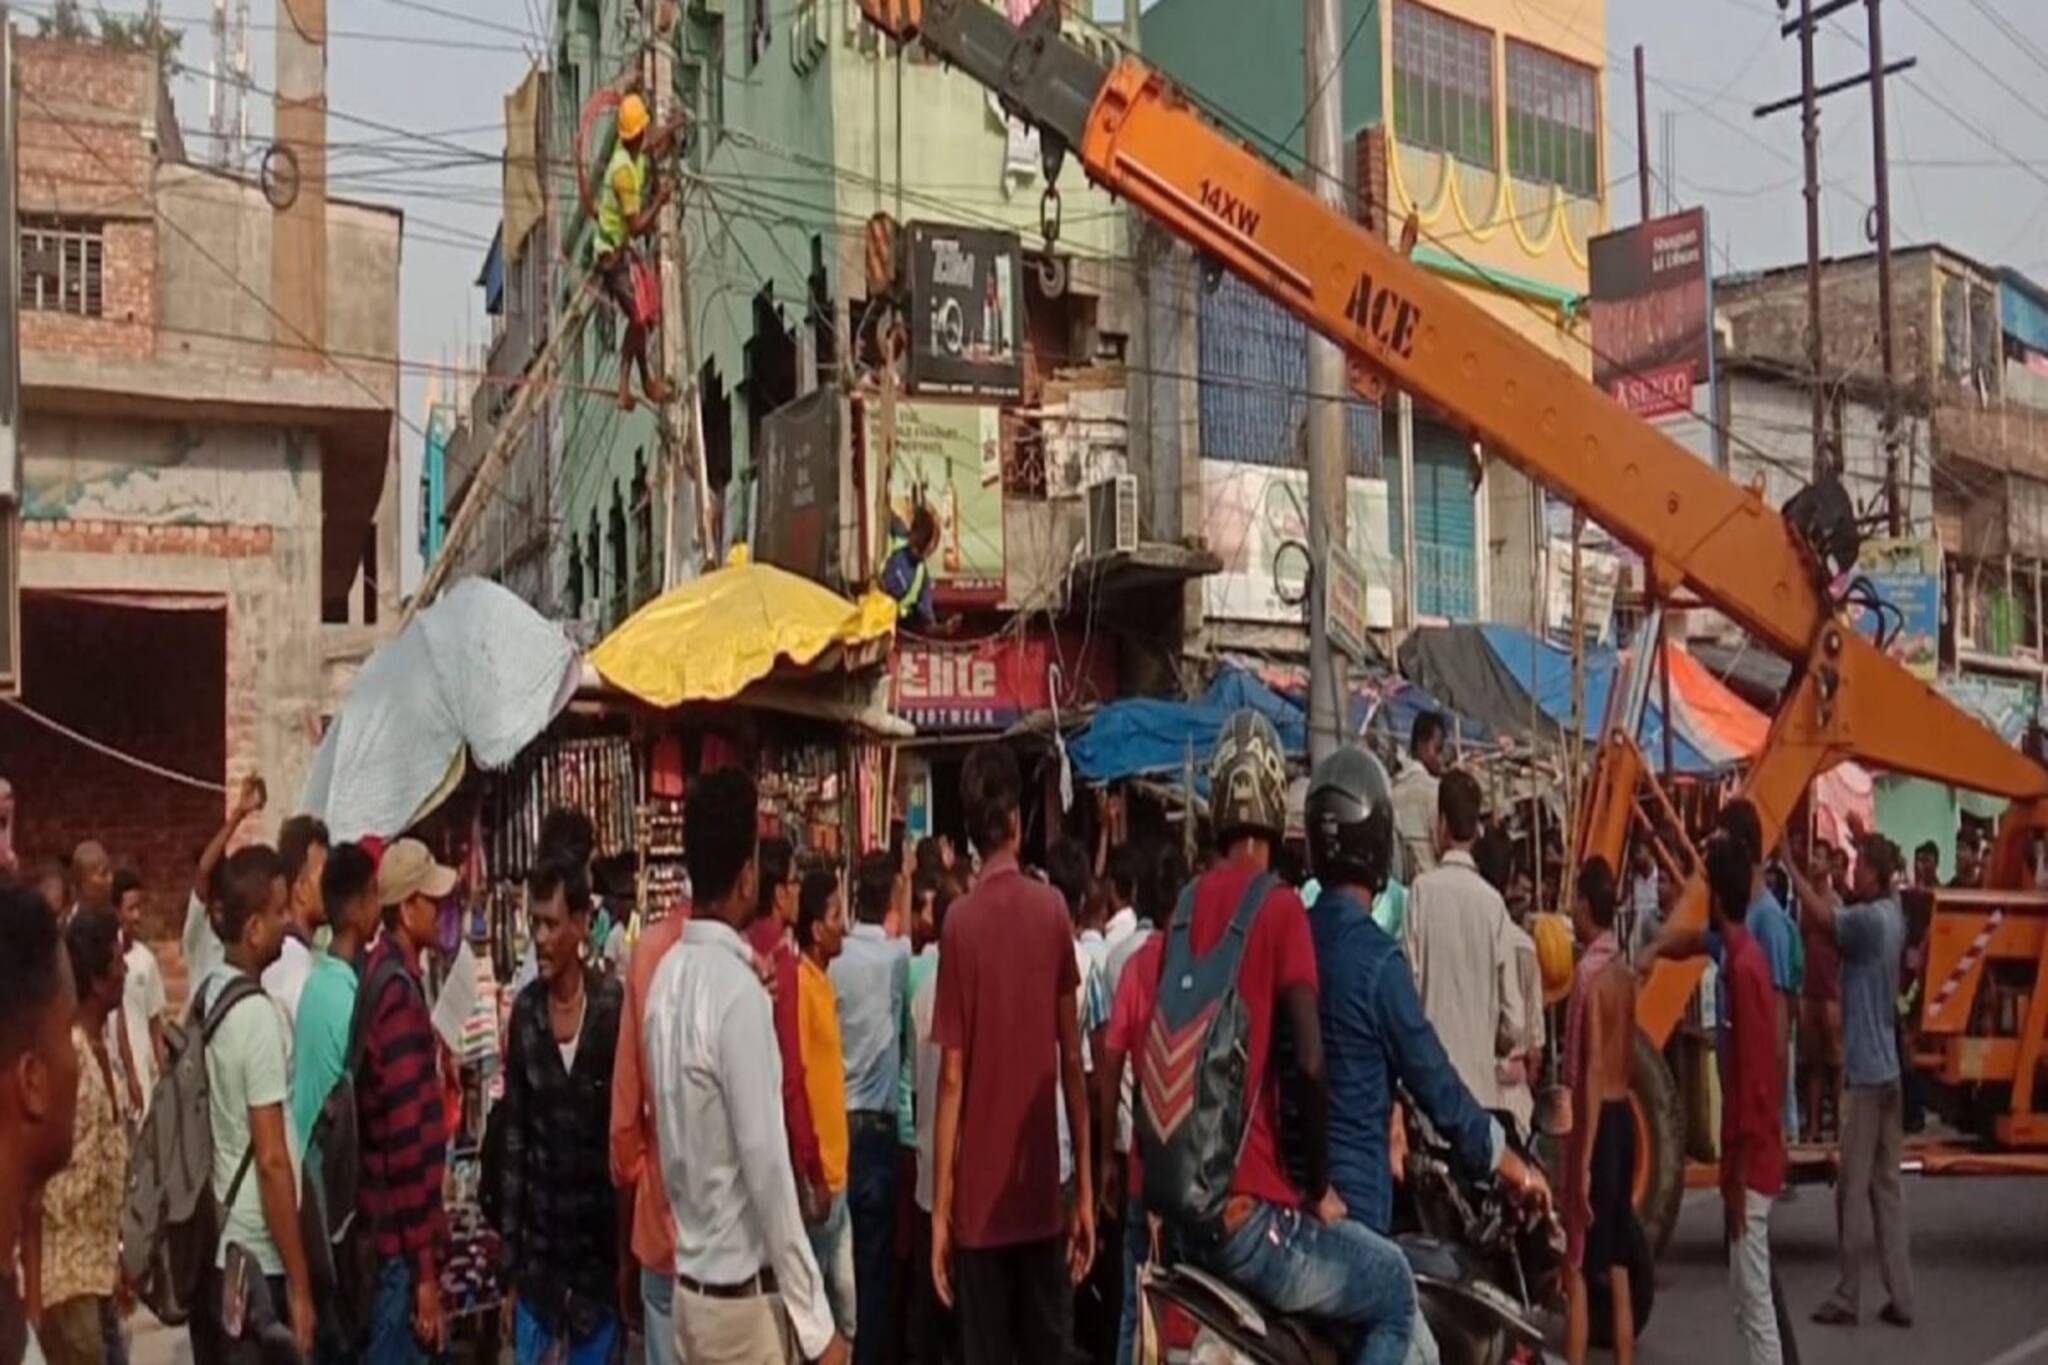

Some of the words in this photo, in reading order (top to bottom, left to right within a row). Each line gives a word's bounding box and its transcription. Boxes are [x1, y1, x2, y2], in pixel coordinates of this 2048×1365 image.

[1198, 179, 1261, 237] 14XW
[1344, 271, 1421, 359] ACE
[900, 645, 997, 698] Elite
[905, 708, 994, 726] FOOTWEAR
